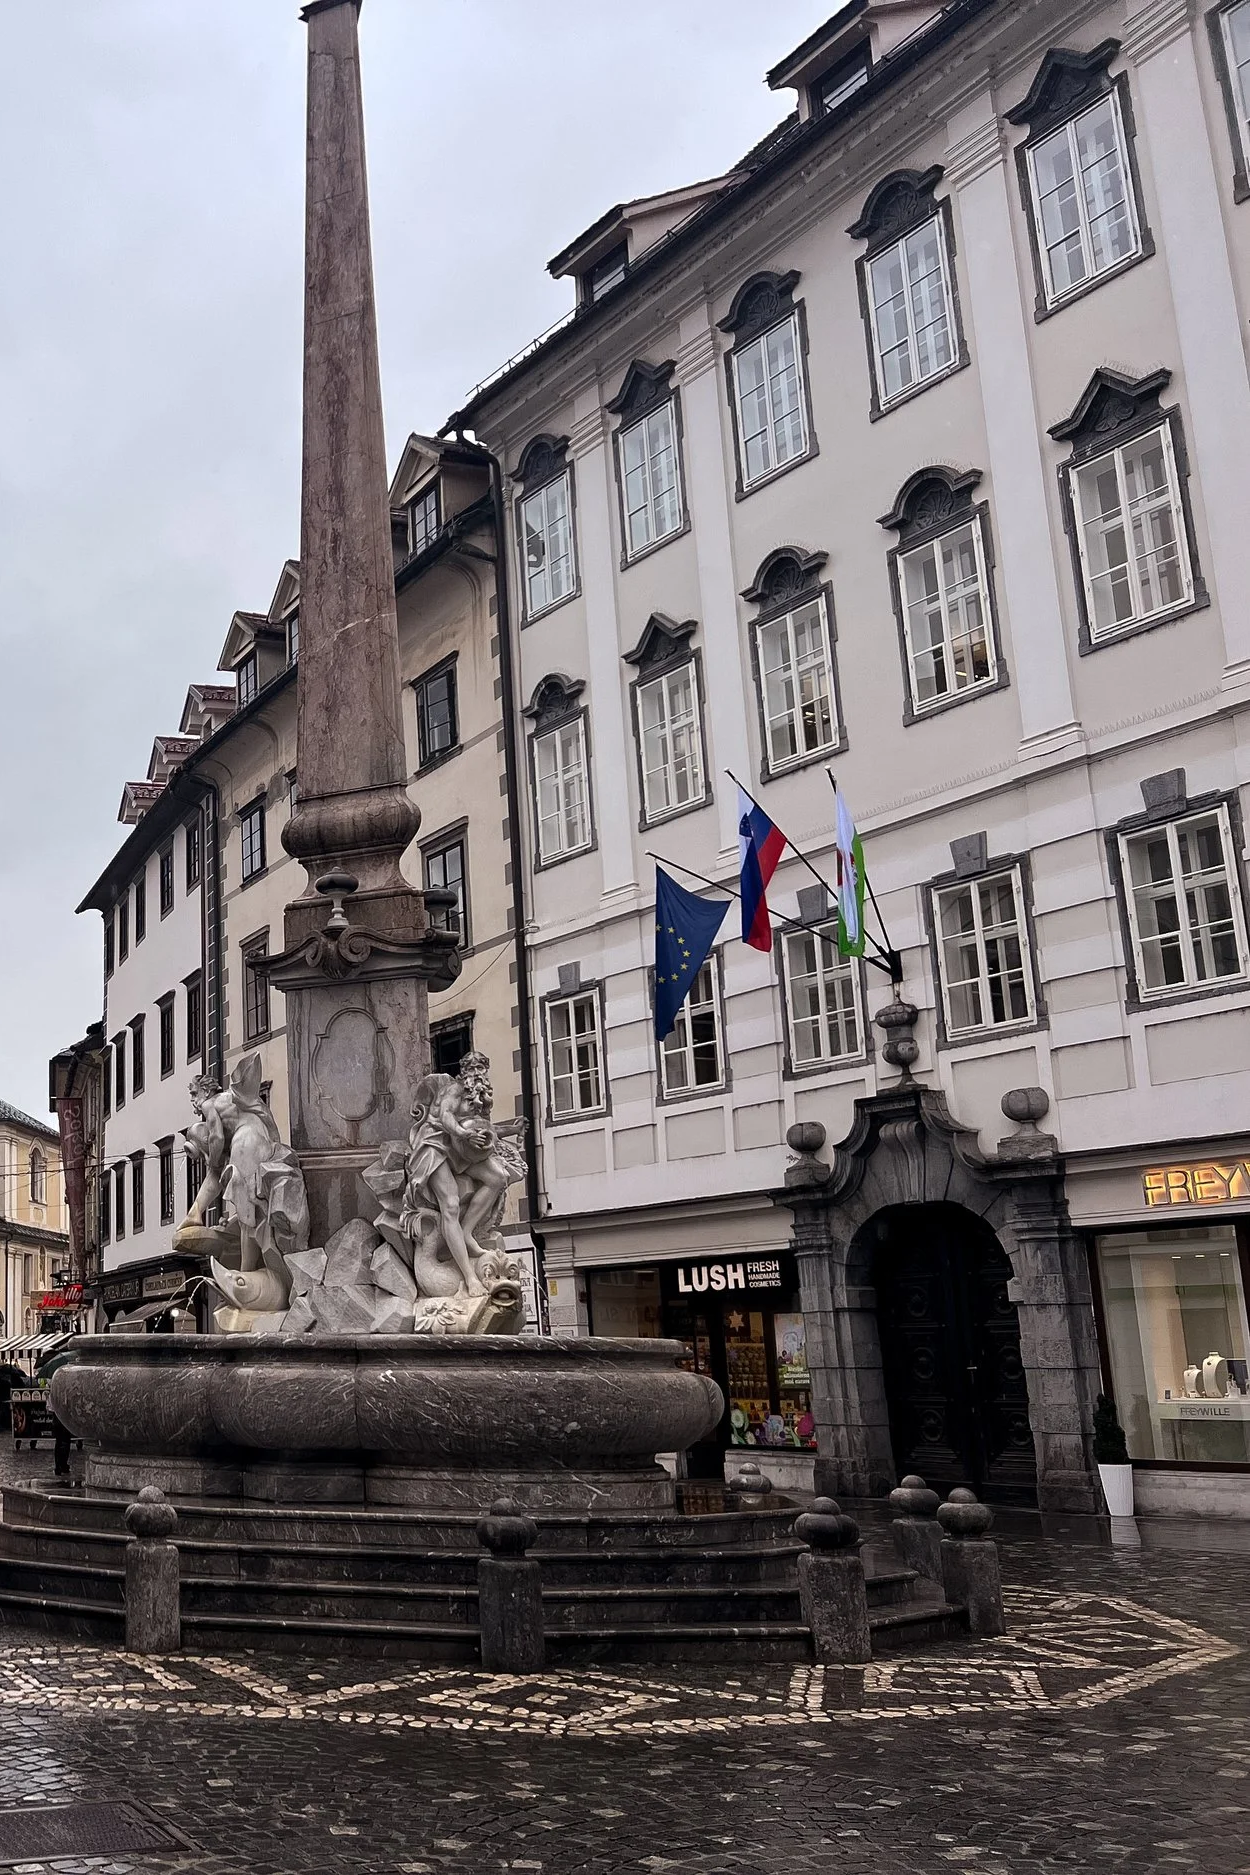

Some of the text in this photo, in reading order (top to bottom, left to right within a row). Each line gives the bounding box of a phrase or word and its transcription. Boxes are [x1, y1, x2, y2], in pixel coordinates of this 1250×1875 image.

[1141, 1163, 1250, 1206] FREY
[678, 1260, 779, 1293] LUSH FRESH
[748, 1272, 781, 1281] HANDMADE
[749, 1280, 782, 1288] COSMETICS
[65, 1286, 83, 1303] illy
